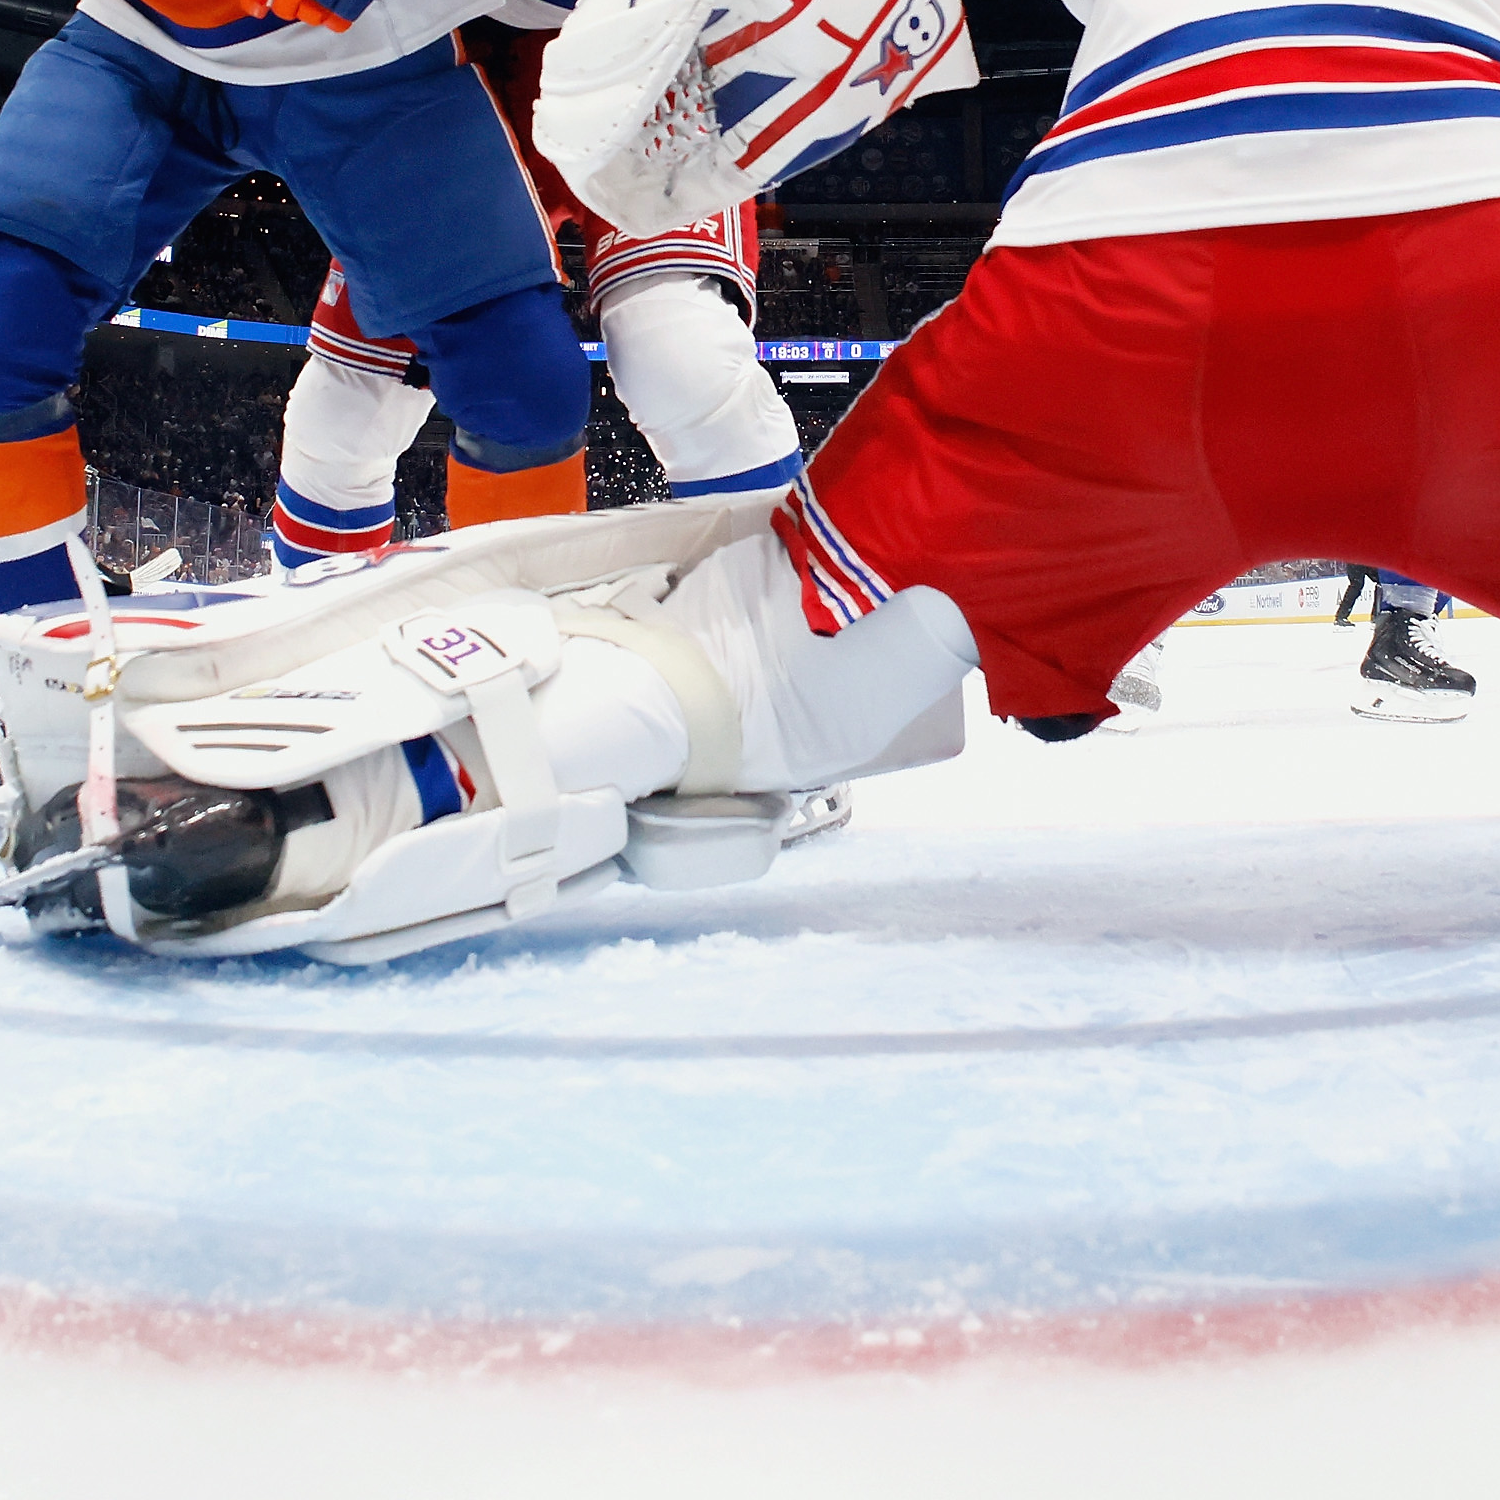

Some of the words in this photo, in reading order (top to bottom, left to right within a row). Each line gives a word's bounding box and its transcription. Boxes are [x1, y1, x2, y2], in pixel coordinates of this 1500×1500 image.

[111, 315, 141, 329] DIME
[198, 325, 229, 339] DIME
[770, 346, 810, 360] 19:03
[850, 343, 862, 358] 0
[422, 627, 482, 667] 31
